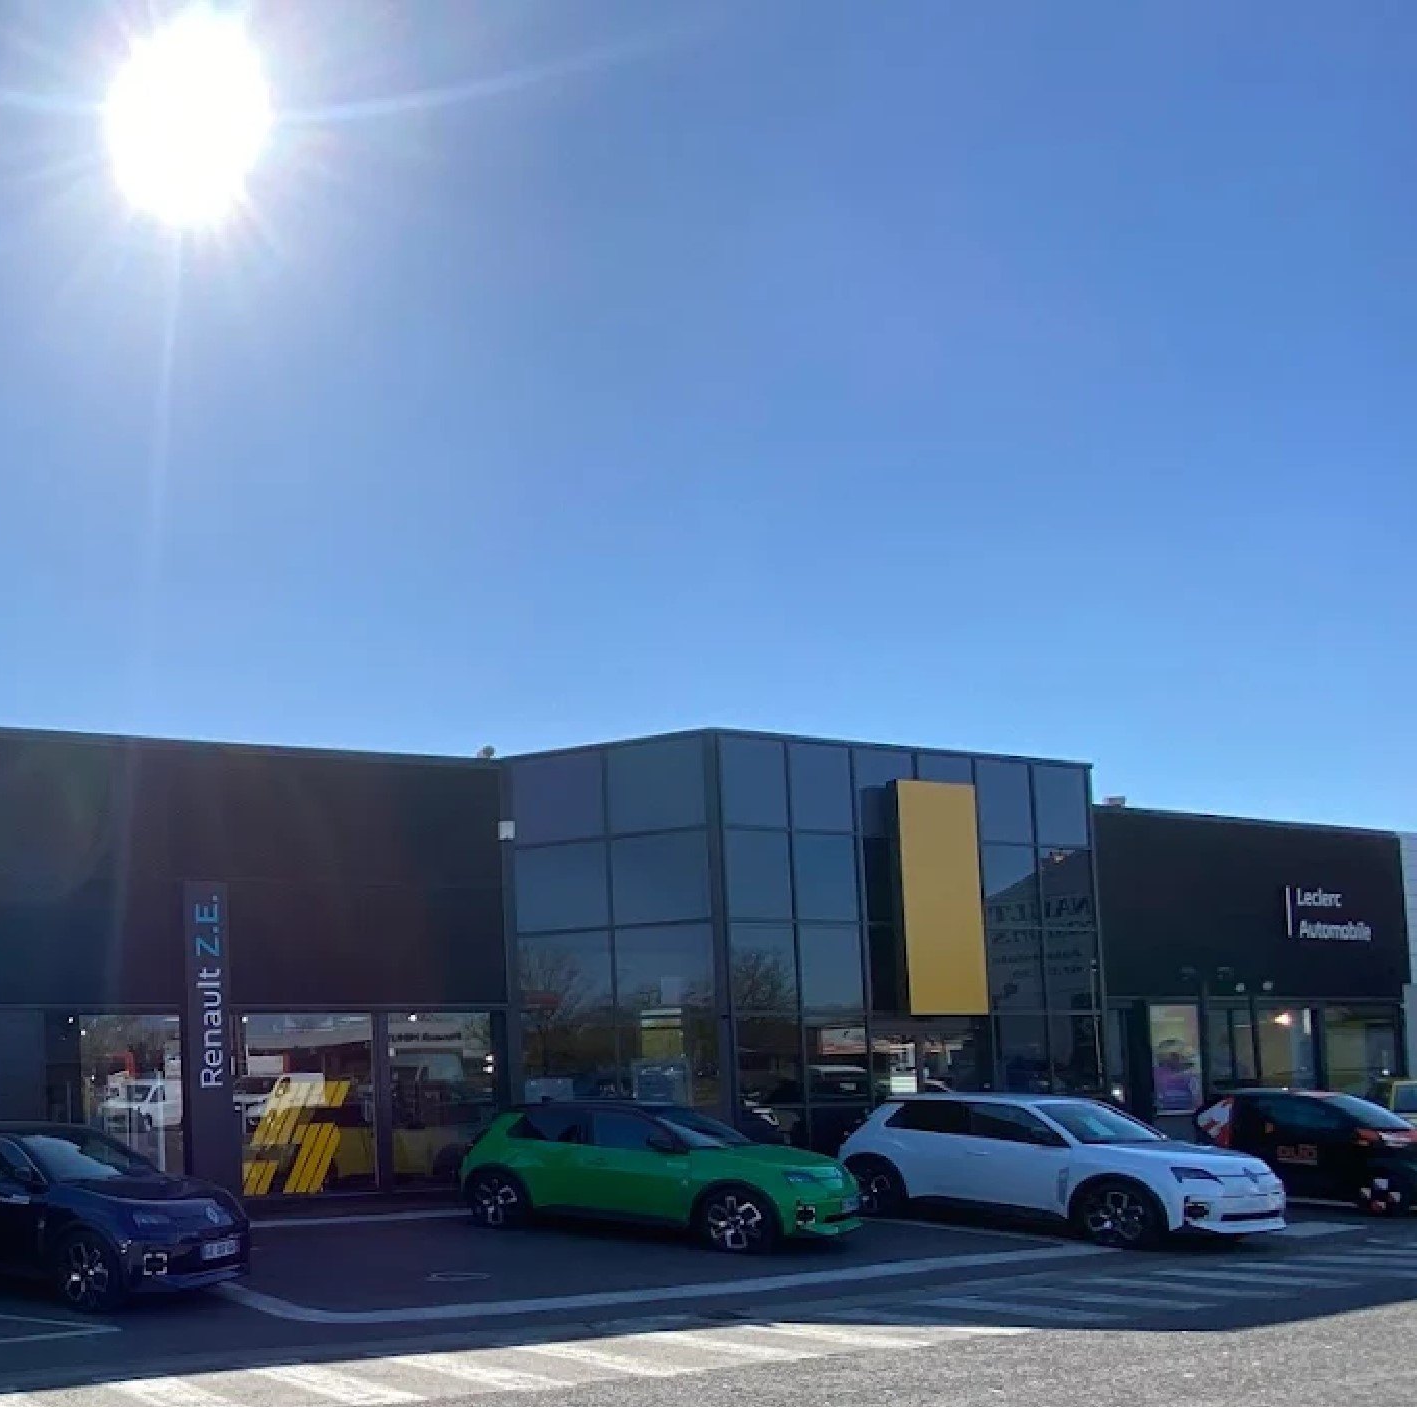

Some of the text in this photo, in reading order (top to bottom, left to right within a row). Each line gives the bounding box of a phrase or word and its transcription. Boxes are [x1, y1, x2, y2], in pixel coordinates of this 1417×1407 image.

[1296, 886, 1343, 908] Leclerc
[1299, 919, 1372, 942] Automobile
[194, 895, 224, 1089] Renault Z.E.
